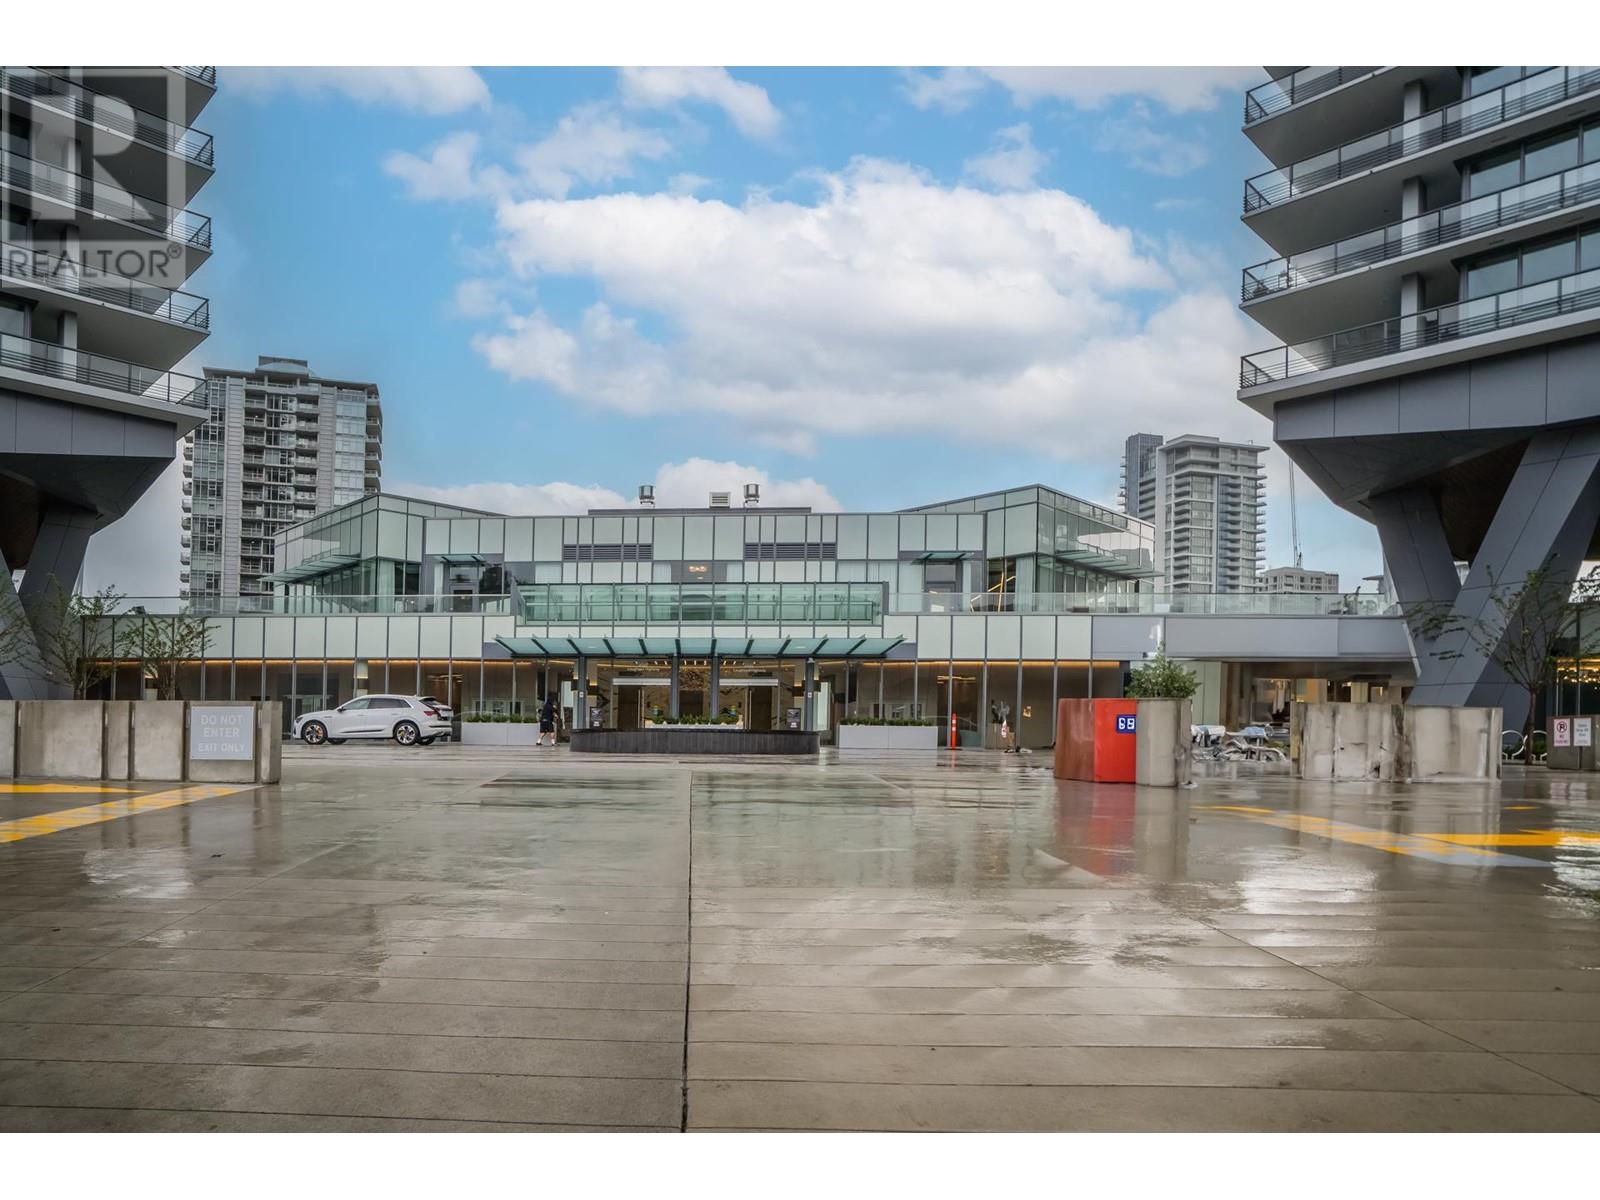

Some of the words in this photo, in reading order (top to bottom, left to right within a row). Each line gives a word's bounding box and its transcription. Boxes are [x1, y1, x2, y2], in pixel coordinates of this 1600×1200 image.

[200, 714, 216, 724] DO
[220, 714, 244, 724] NOT
[203, 727, 240, 737] ENTER
[198, 743, 218, 752] EXIT
[220, 743, 245, 752] ONLY
